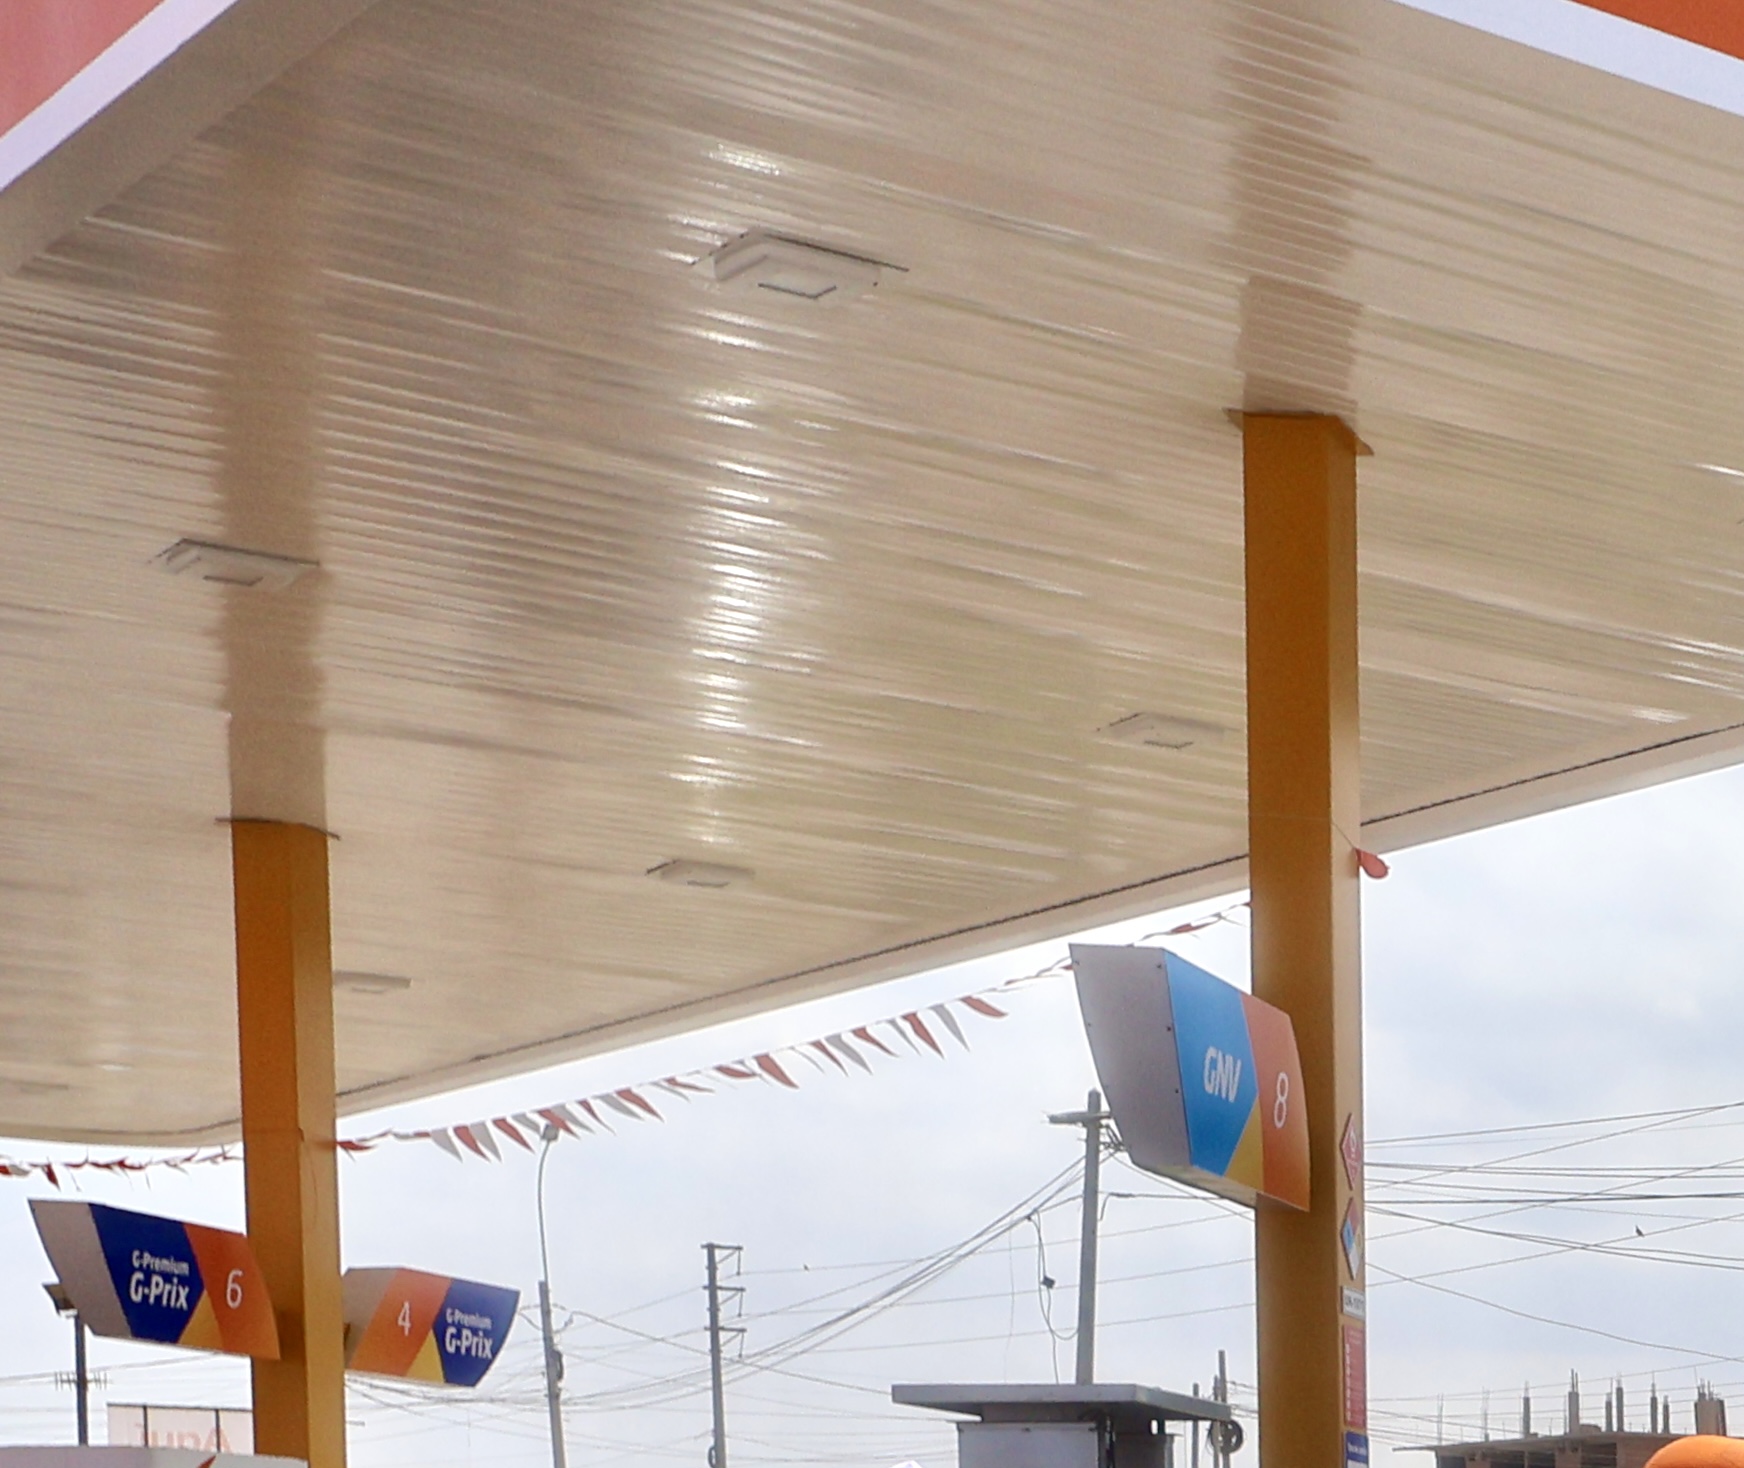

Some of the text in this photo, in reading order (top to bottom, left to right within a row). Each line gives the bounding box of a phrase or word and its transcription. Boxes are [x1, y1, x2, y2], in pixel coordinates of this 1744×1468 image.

[1203, 1046, 1242, 1103] GNV
[1273, 1071, 1290, 1129] 8
[131, 1249, 190, 1276] G-Premium
[129, 1271, 190, 1311] G-Prix
[225, 1269, 244, 1310] 6
[397, 1301, 412, 1337] 4
[445, 1306, 492, 1330] G-Premium
[444, 1325, 493, 1360] G-Prix
